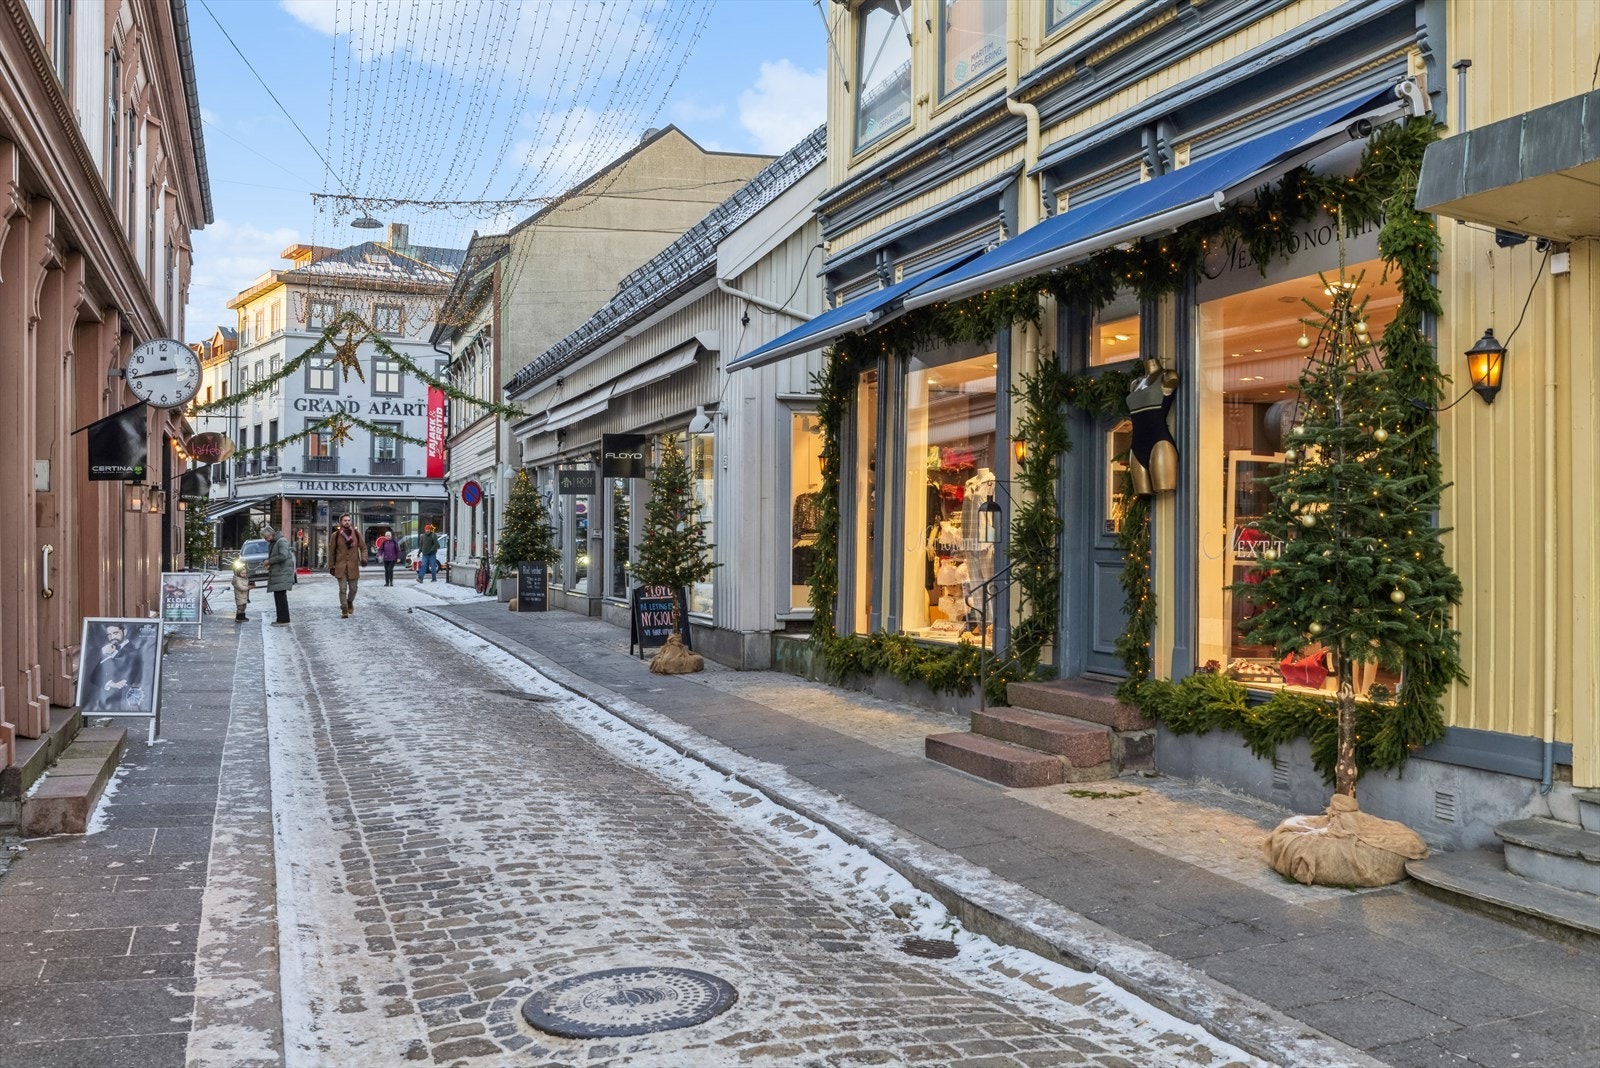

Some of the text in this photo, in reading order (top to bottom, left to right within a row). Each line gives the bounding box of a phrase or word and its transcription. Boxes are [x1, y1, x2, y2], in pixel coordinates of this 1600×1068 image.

[146, 347, 154, 355] 11
[159, 344, 168, 352] 12
[136, 355, 145, 364] 10
[184, 356, 192, 365] 2
[131, 368, 139, 377] 9
[189, 368, 196, 378] 3
[135, 381, 143, 389] 8
[184, 381, 191, 389] 4
[146, 390, 153, 399] 7
[160, 394, 168, 402] 6
[175, 390, 182, 399] 5
[293, 397, 361, 414] GRAND
[429, 418, 437, 457] KAJAKK
[605, 452, 643, 460] FLOYD
[297, 481, 328, 491] THAI
[333, 482, 412, 492] RESTAURANT
[1202, 521, 1271, 560] NEXT
